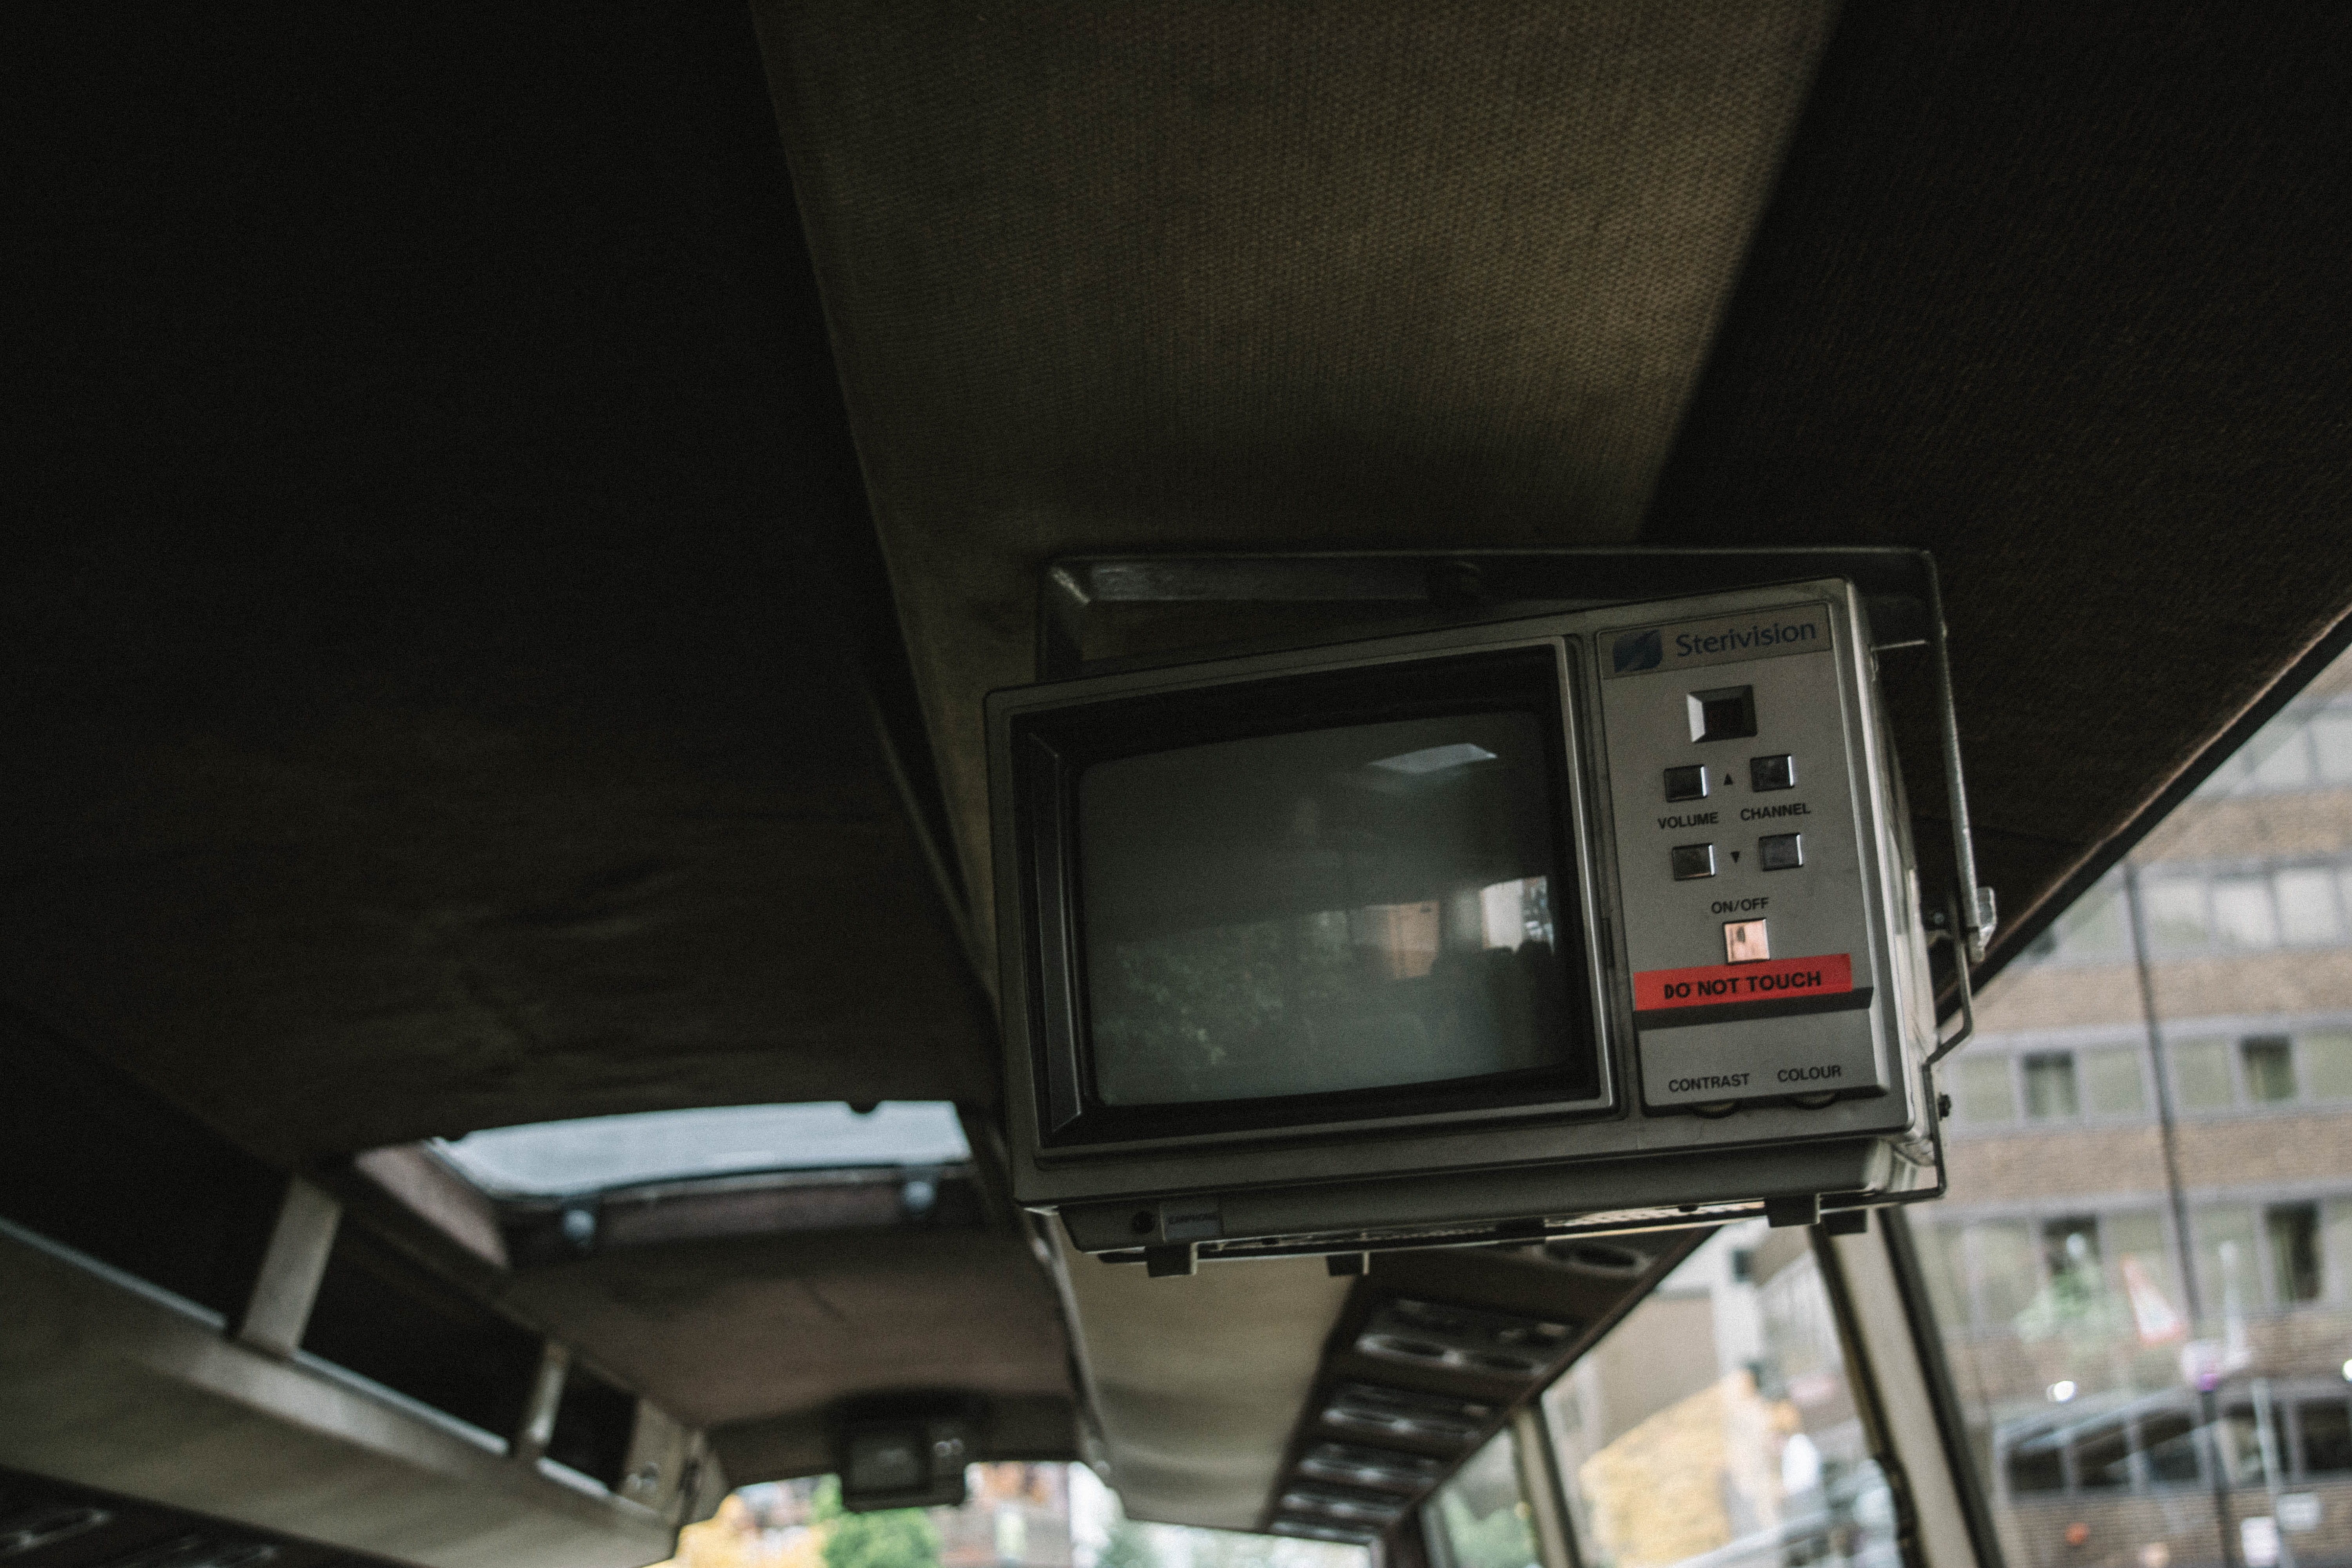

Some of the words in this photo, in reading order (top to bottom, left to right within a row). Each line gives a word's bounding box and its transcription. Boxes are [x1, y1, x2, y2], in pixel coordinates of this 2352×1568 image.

[1675, 622, 1817, 657] Sterivision
[1658, 812, 1719, 829] VOLUME
[1740, 804, 1811, 821] CHANNEL
[1711, 897, 1769, 914] ON/OFF
[1664, 983, 1690, 999] DO
[1697, 979, 1739, 996] NOT
[1746, 971, 1822, 992] TOUCH
[1777, 1065, 1841, 1082] COLOUR
[1668, 1073, 1749, 1093] CONTRAST
